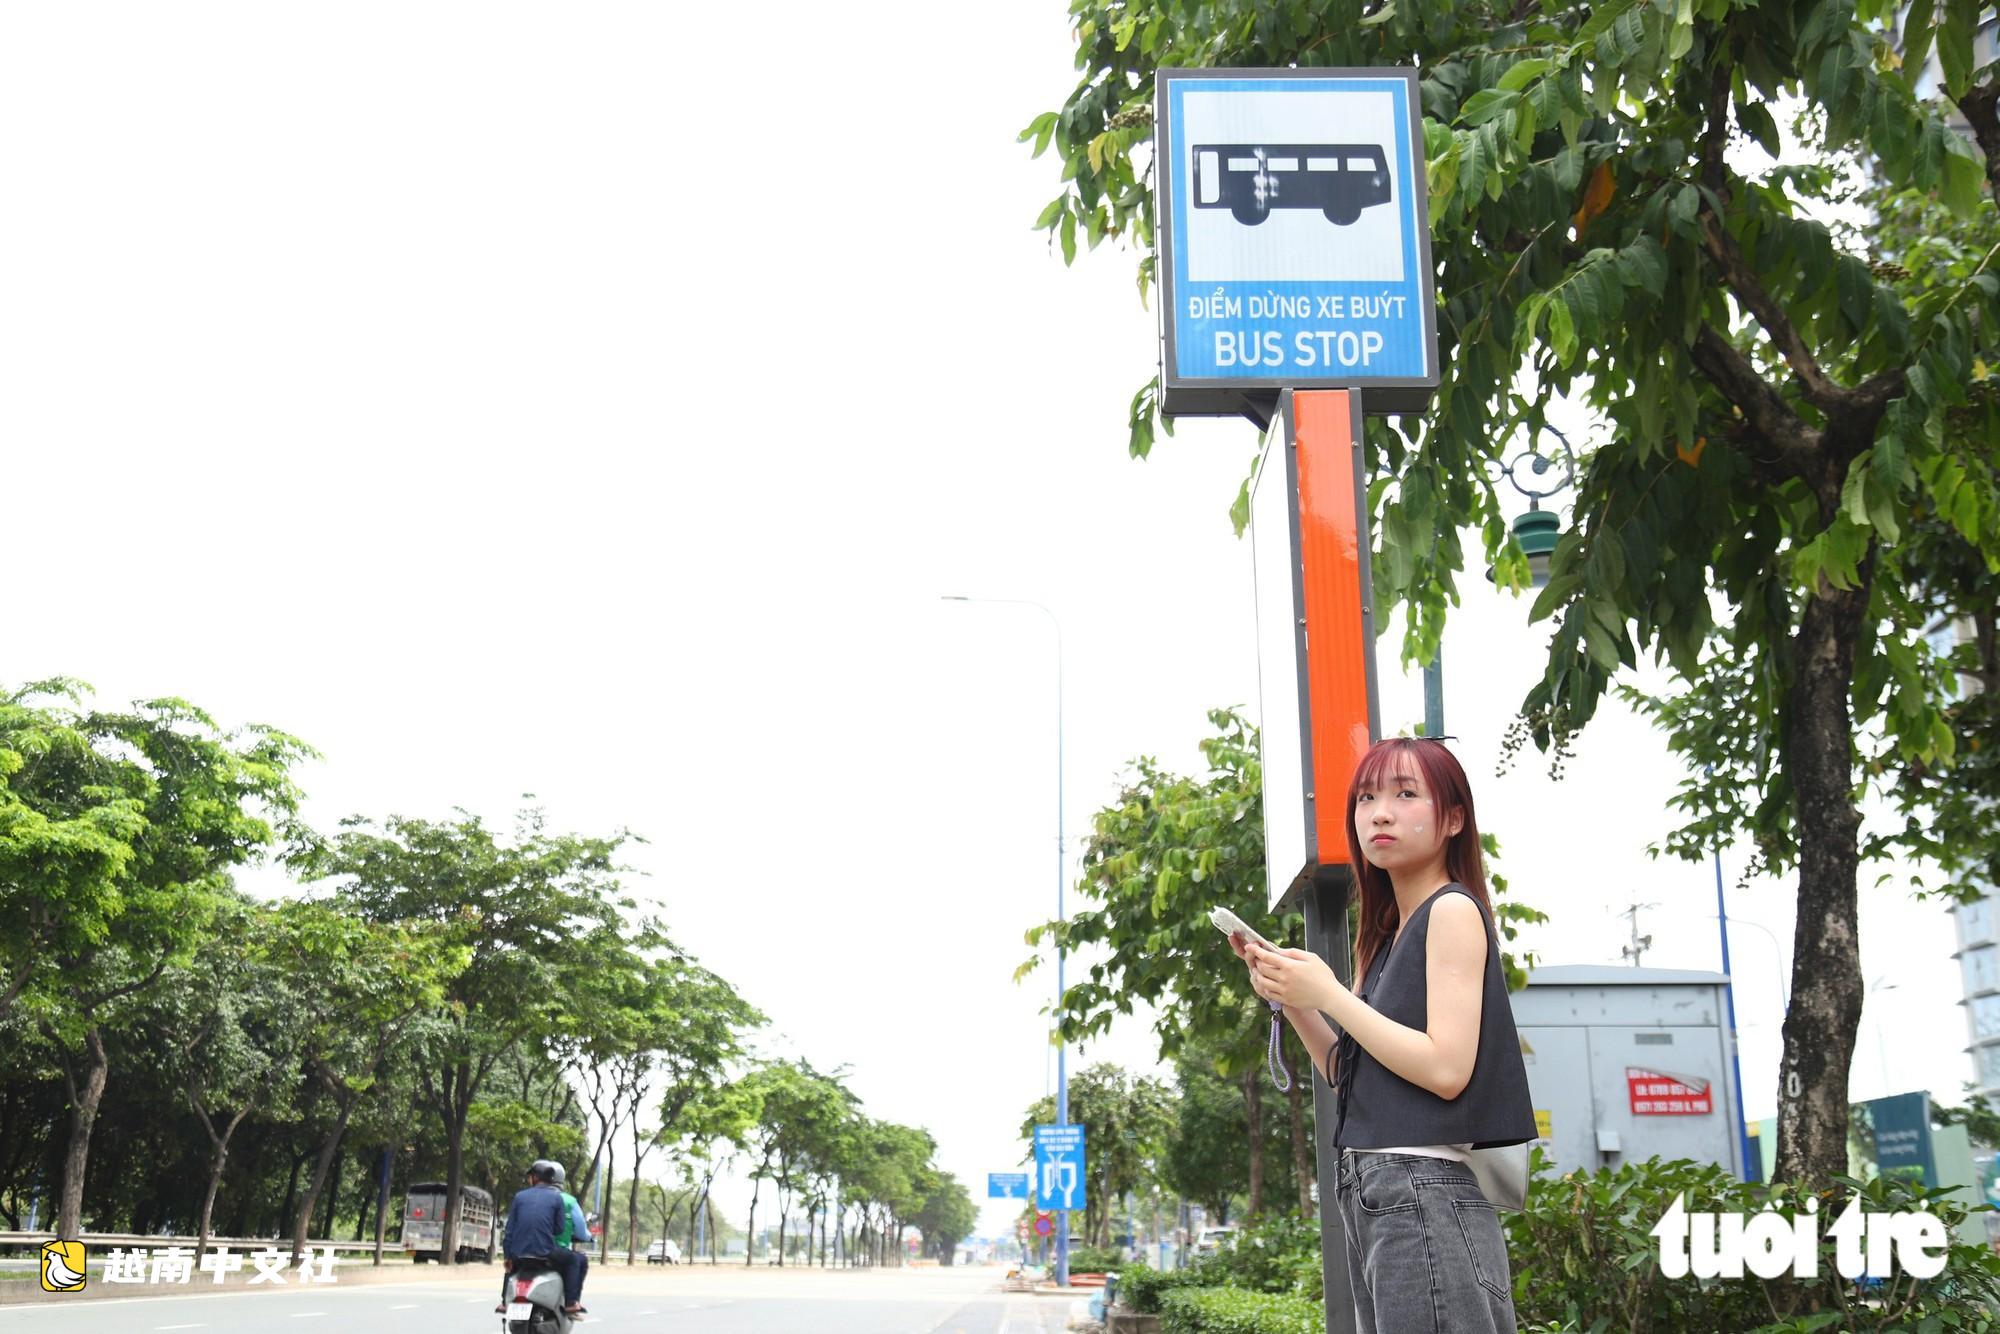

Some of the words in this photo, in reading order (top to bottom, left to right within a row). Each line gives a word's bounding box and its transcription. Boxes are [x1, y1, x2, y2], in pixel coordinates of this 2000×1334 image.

[1189, 287, 1242, 319] ĐIỂM
[1250, 290, 1311, 319] DỪNG
[1317, 296, 1344, 319] XE
[1351, 290, 1406, 319] BUÝT
[1215, 331, 1284, 367] BUS
[1294, 331, 1383, 367] STOP
